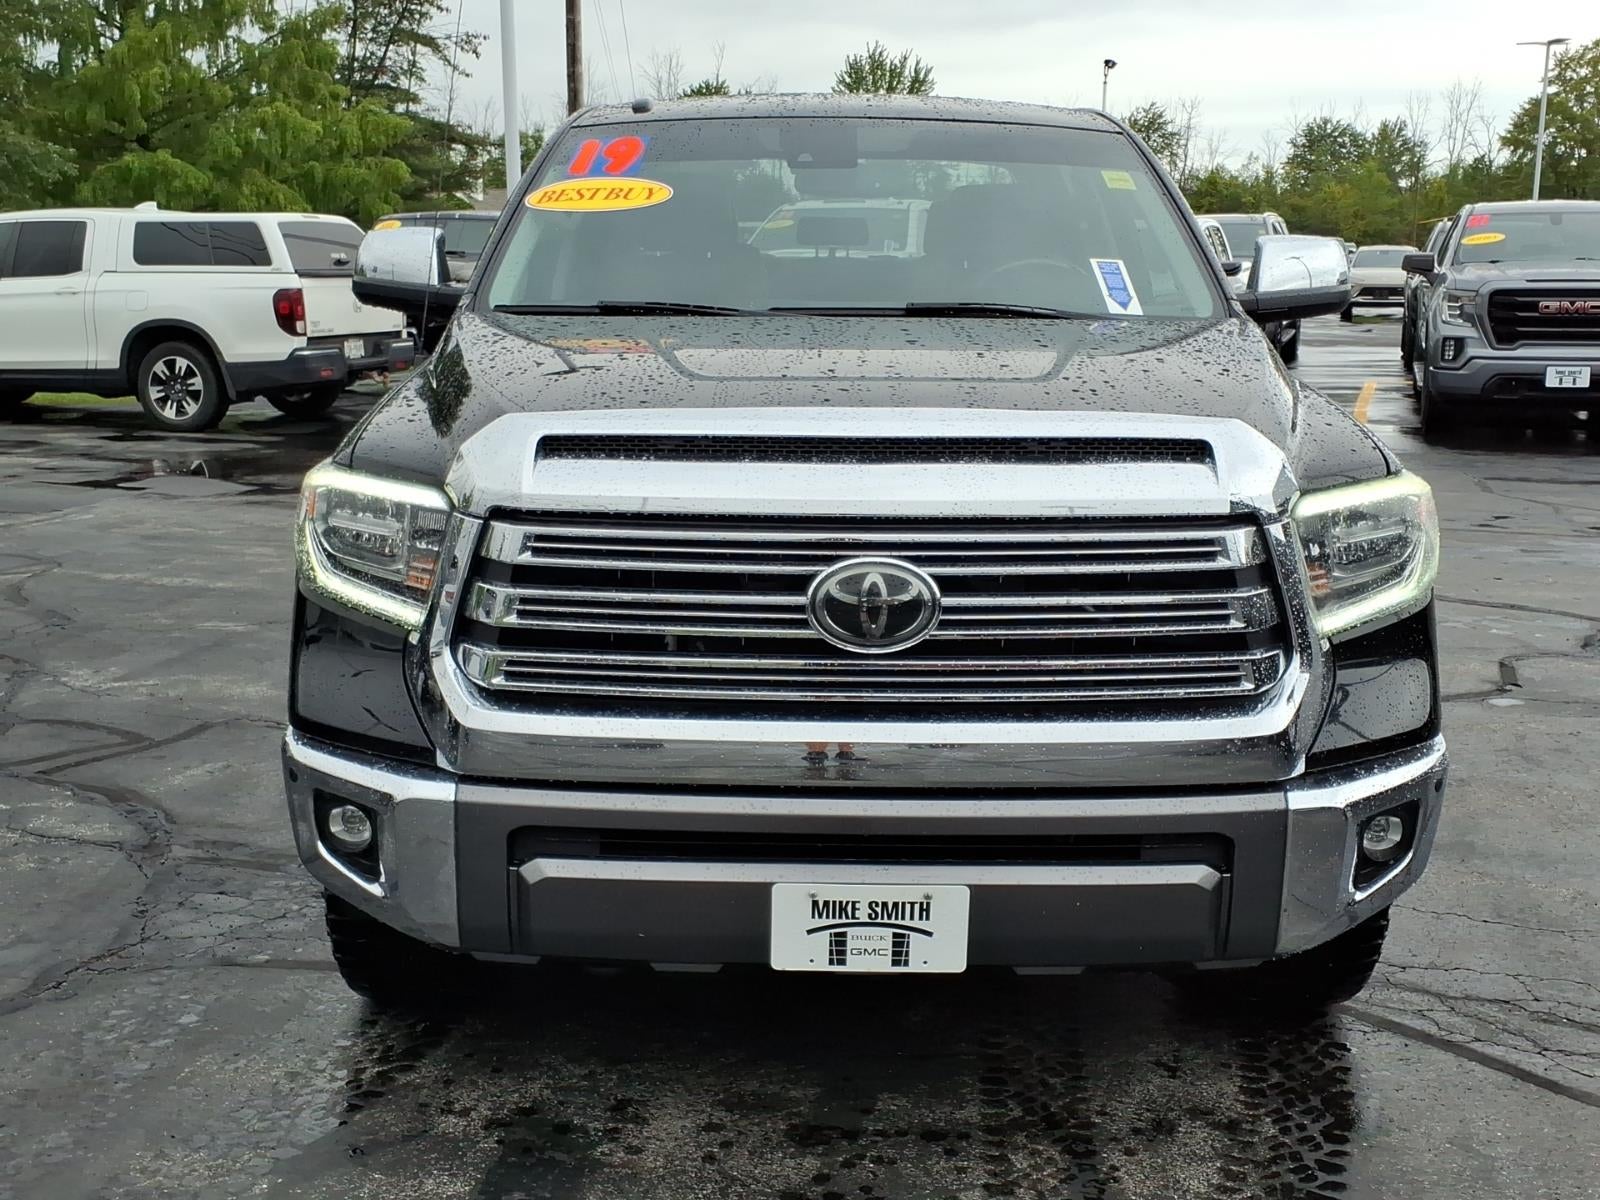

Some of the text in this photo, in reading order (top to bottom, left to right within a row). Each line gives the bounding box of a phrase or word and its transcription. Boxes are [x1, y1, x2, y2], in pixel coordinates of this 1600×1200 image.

[567, 135, 646, 177] 19
[536, 186, 663, 204] BEST BUY
[1539, 301, 1600, 314] GMC
[811, 899, 931, 921] MIKE SMITH
[850, 947, 889, 957] GMC
